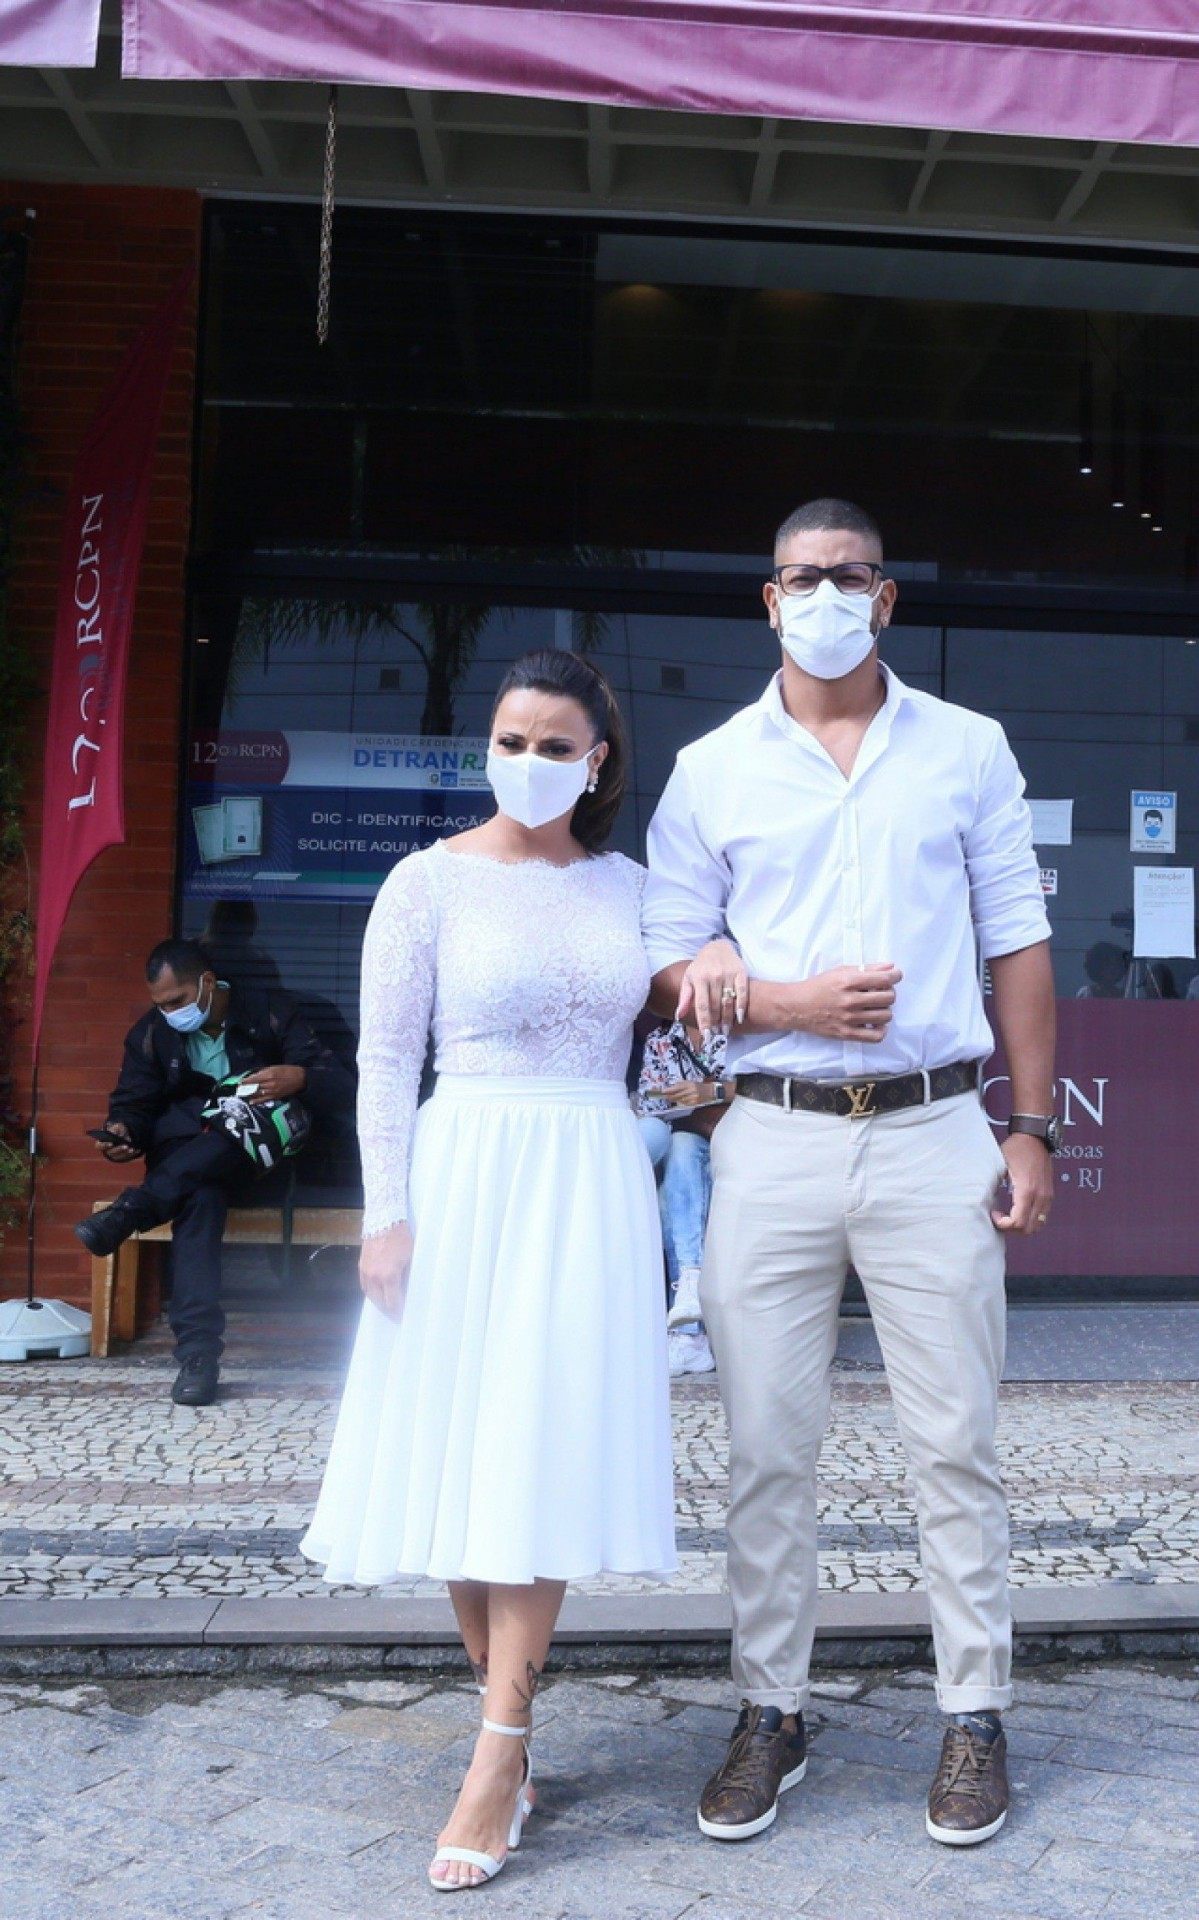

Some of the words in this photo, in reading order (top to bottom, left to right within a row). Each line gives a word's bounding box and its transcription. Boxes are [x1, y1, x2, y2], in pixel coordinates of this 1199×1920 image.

[75, 492, 104, 650] RCPN
[356, 736, 407, 747] UNIDADE
[239, 743, 283, 758] RCPN
[353, 749, 458, 769] DETRAN
[1137, 796, 1171, 807] AVISO
[312, 812, 342, 824] DIC
[297, 838, 366, 852] SOLICITE
[370, 841, 408, 854] AQUI
